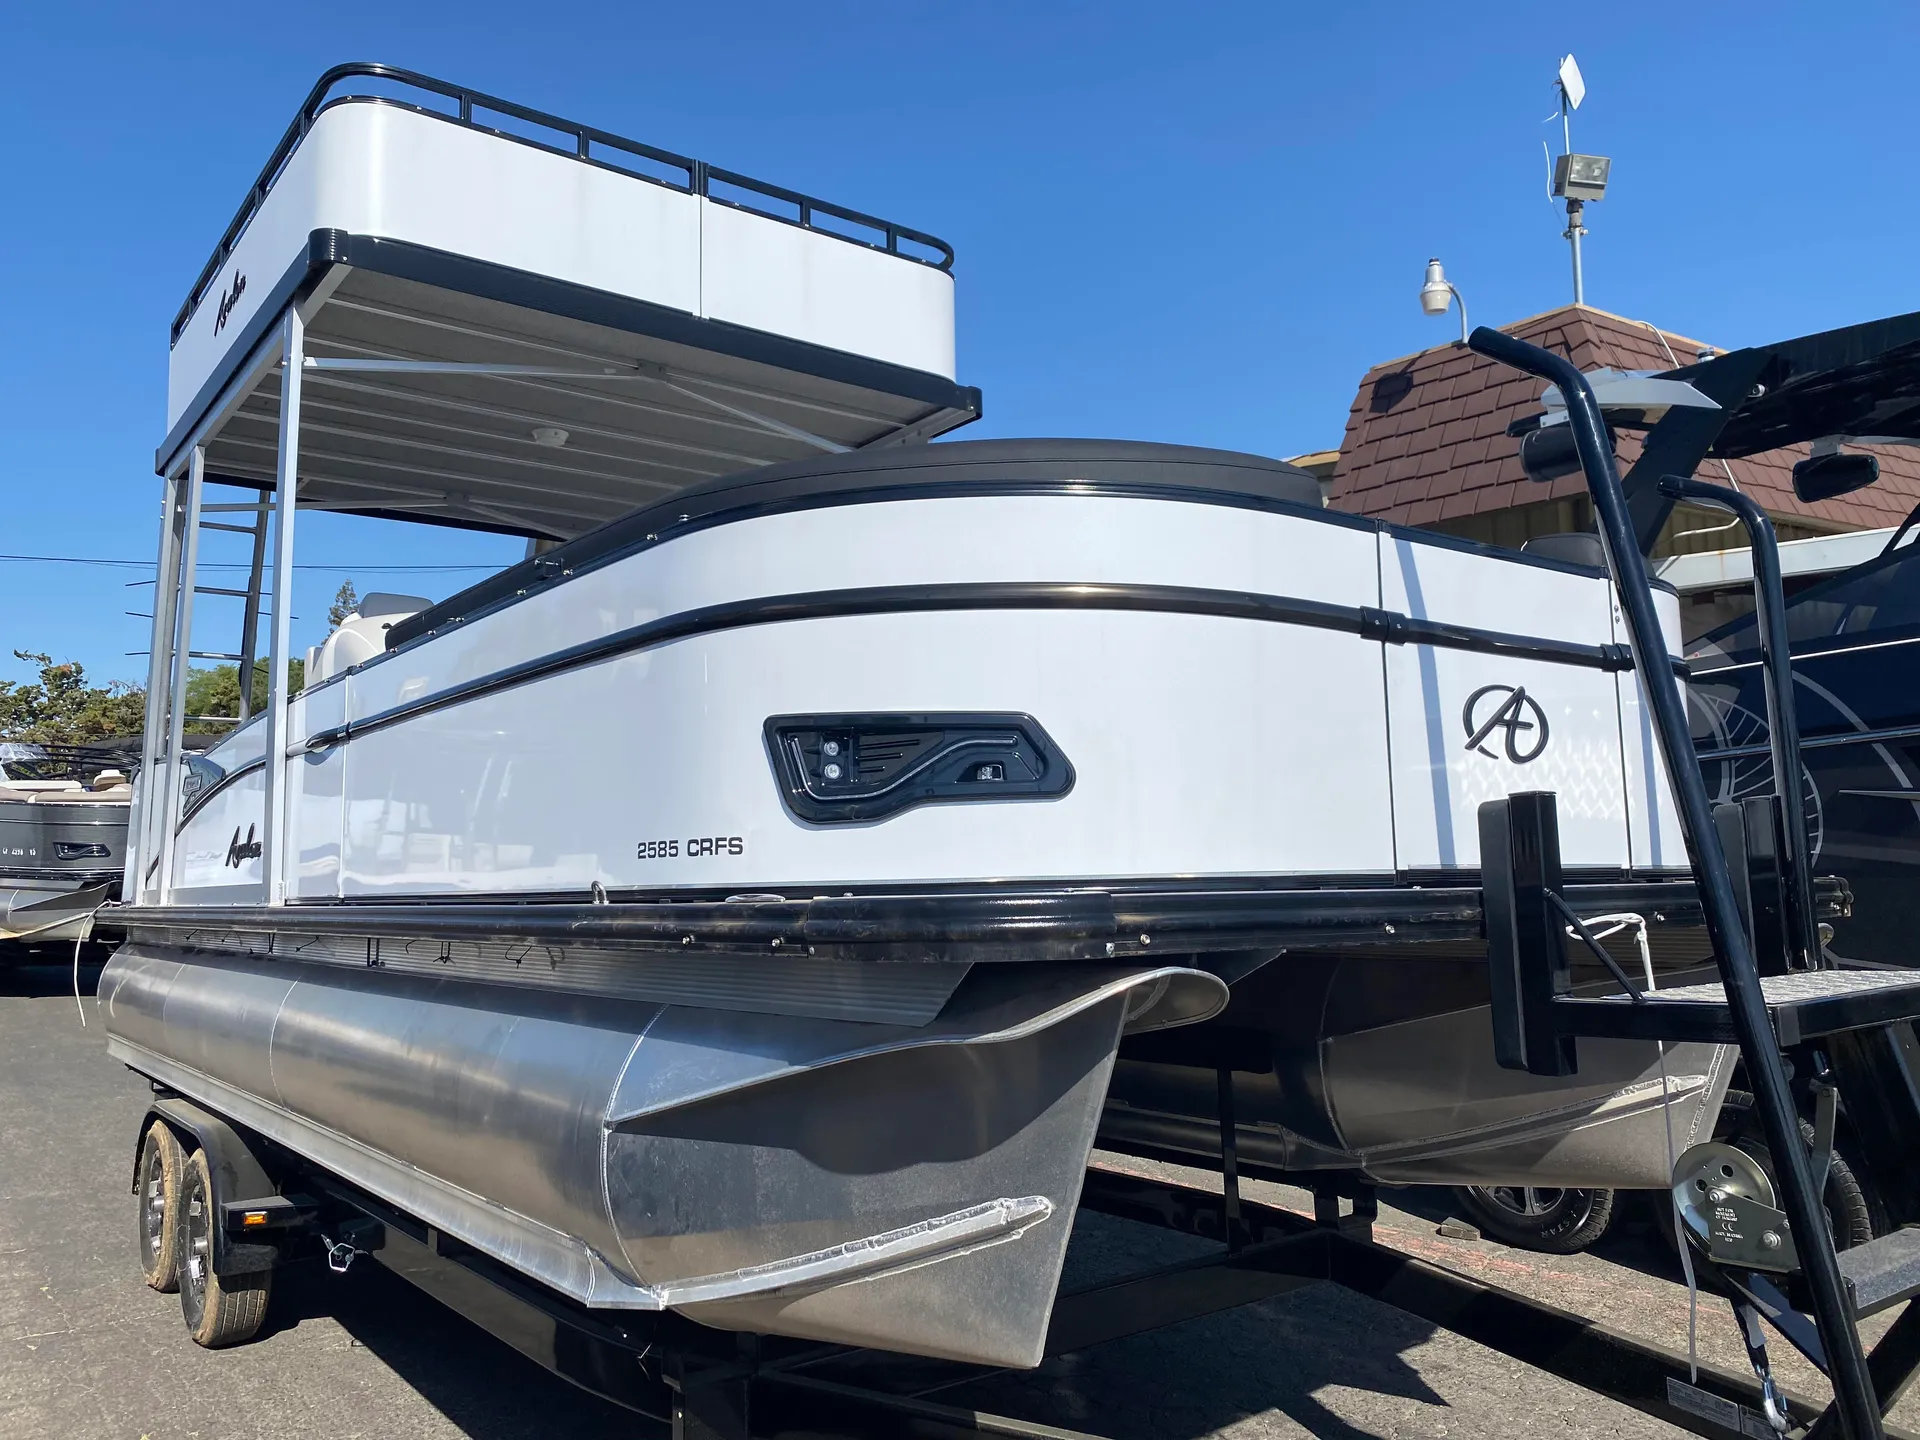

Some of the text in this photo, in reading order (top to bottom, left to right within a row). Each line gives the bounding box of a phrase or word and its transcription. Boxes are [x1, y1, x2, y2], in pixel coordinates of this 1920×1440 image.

[214, 268, 246, 337] Avalon
[225, 822, 262, 869] Avalon
[637, 837, 744, 859] 2585 CRFS
